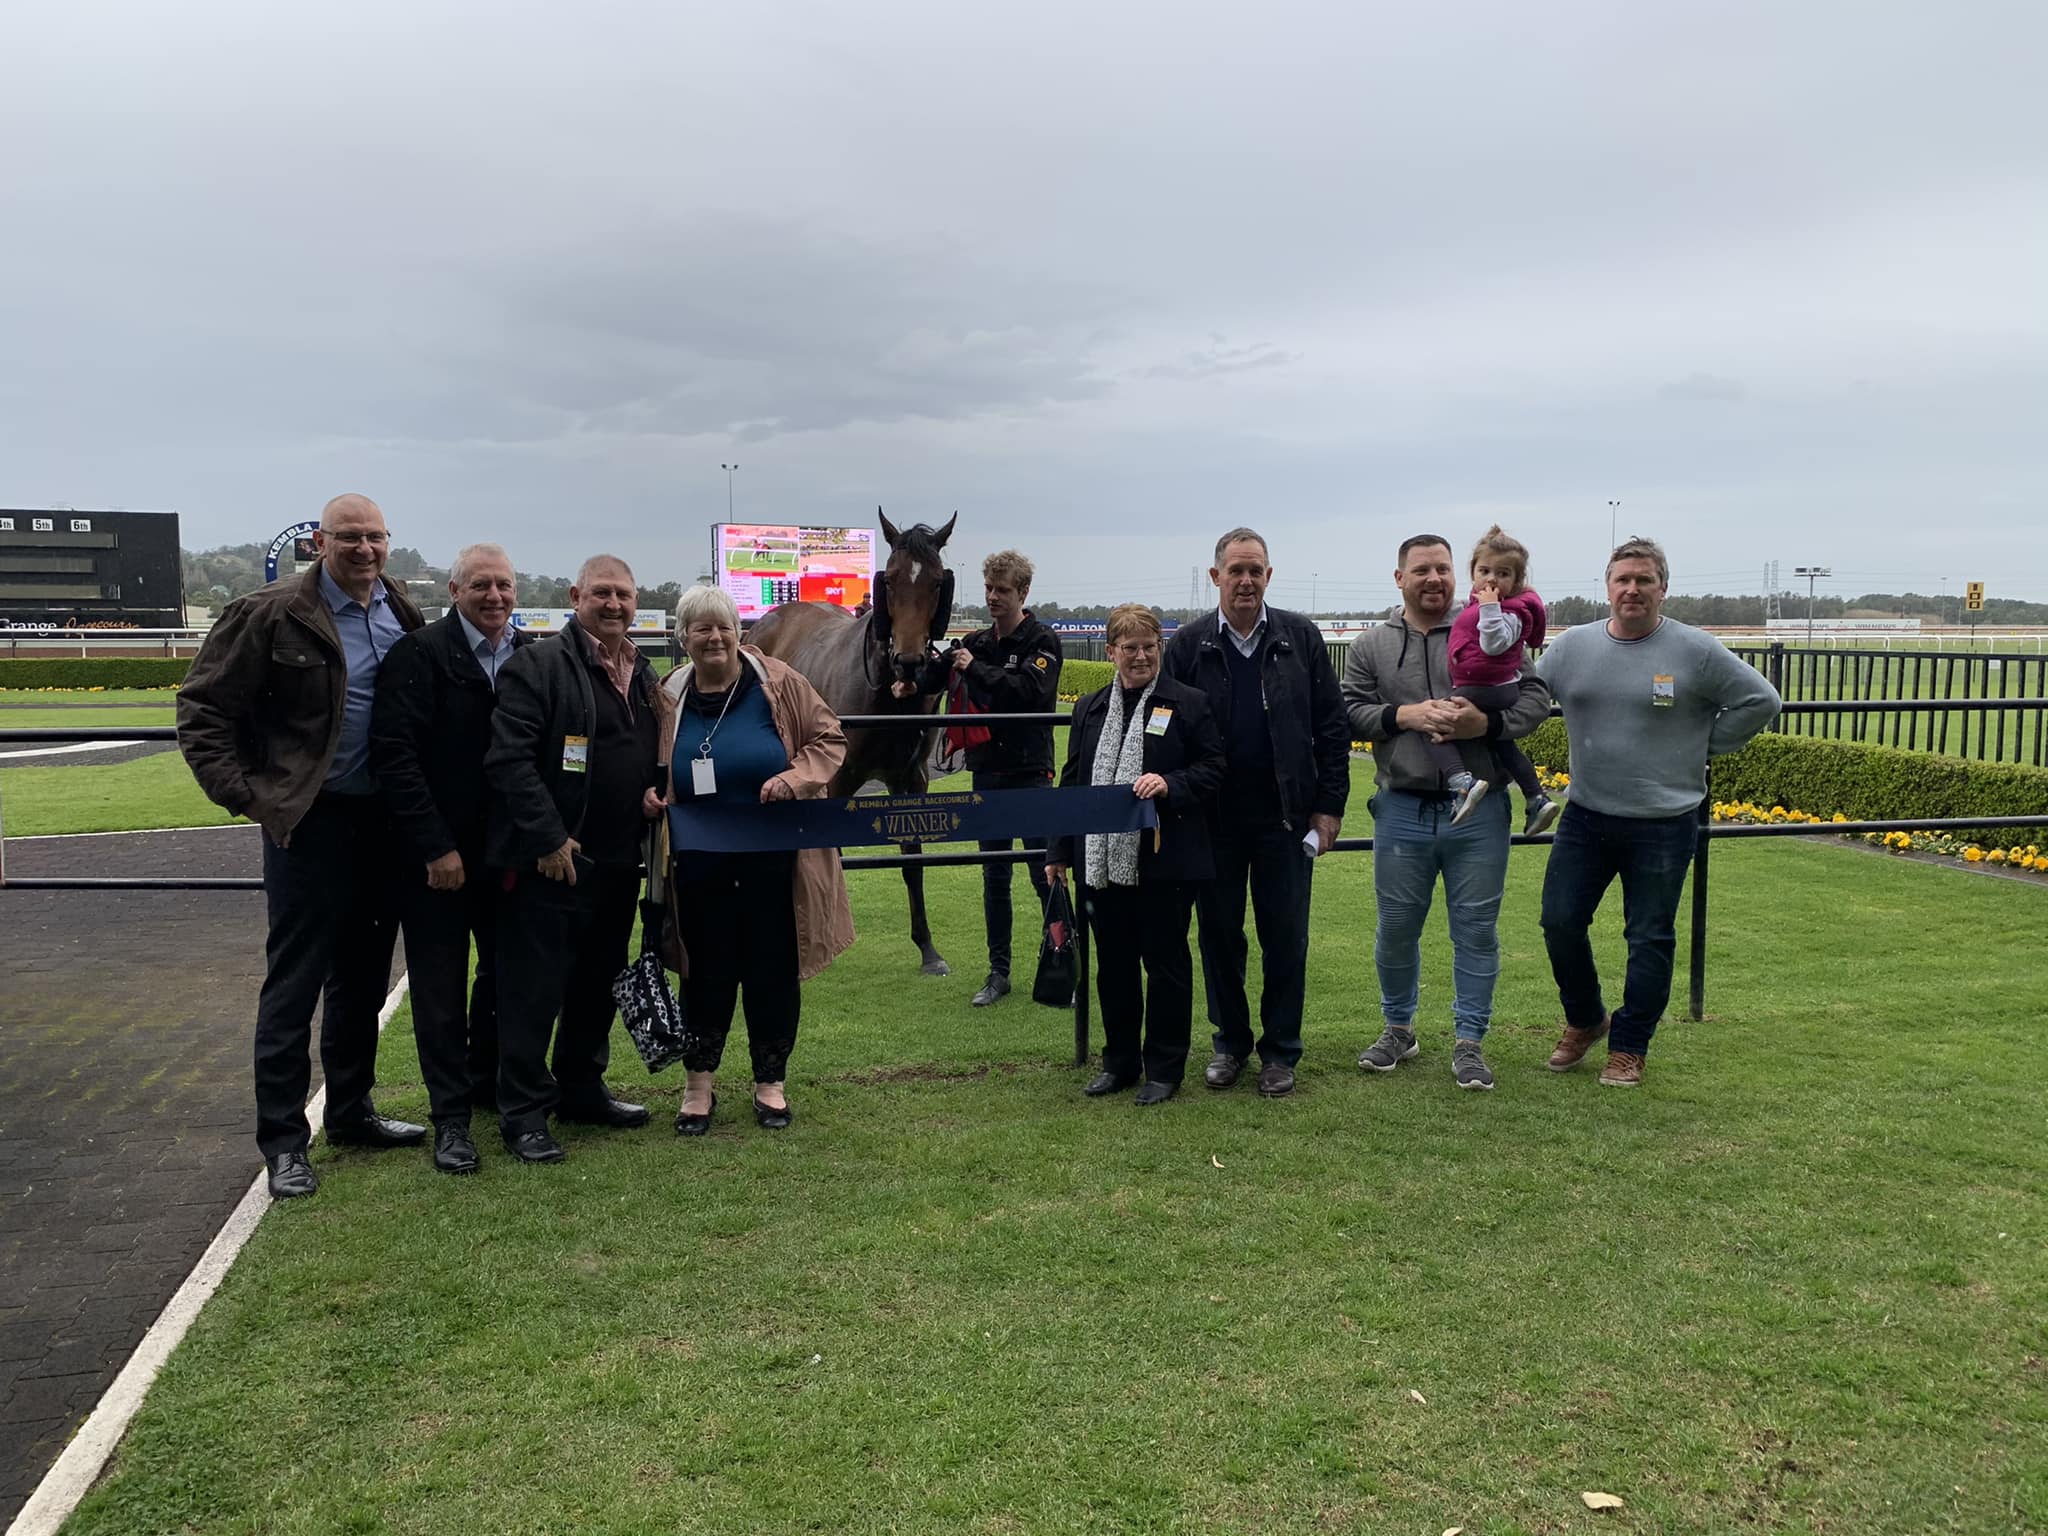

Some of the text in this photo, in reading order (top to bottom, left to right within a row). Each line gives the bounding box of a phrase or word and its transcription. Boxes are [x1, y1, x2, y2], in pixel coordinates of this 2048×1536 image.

[35, 519, 50, 530] 5th
[73, 520, 89, 530] 6th
[268, 523, 313, 559] KEMBLA
[1051, 623, 1107, 632] CARLTON
[859, 794, 971, 808] KEMBLA GRANGE RACECOURSE
[884, 811, 950, 834] WINNER
